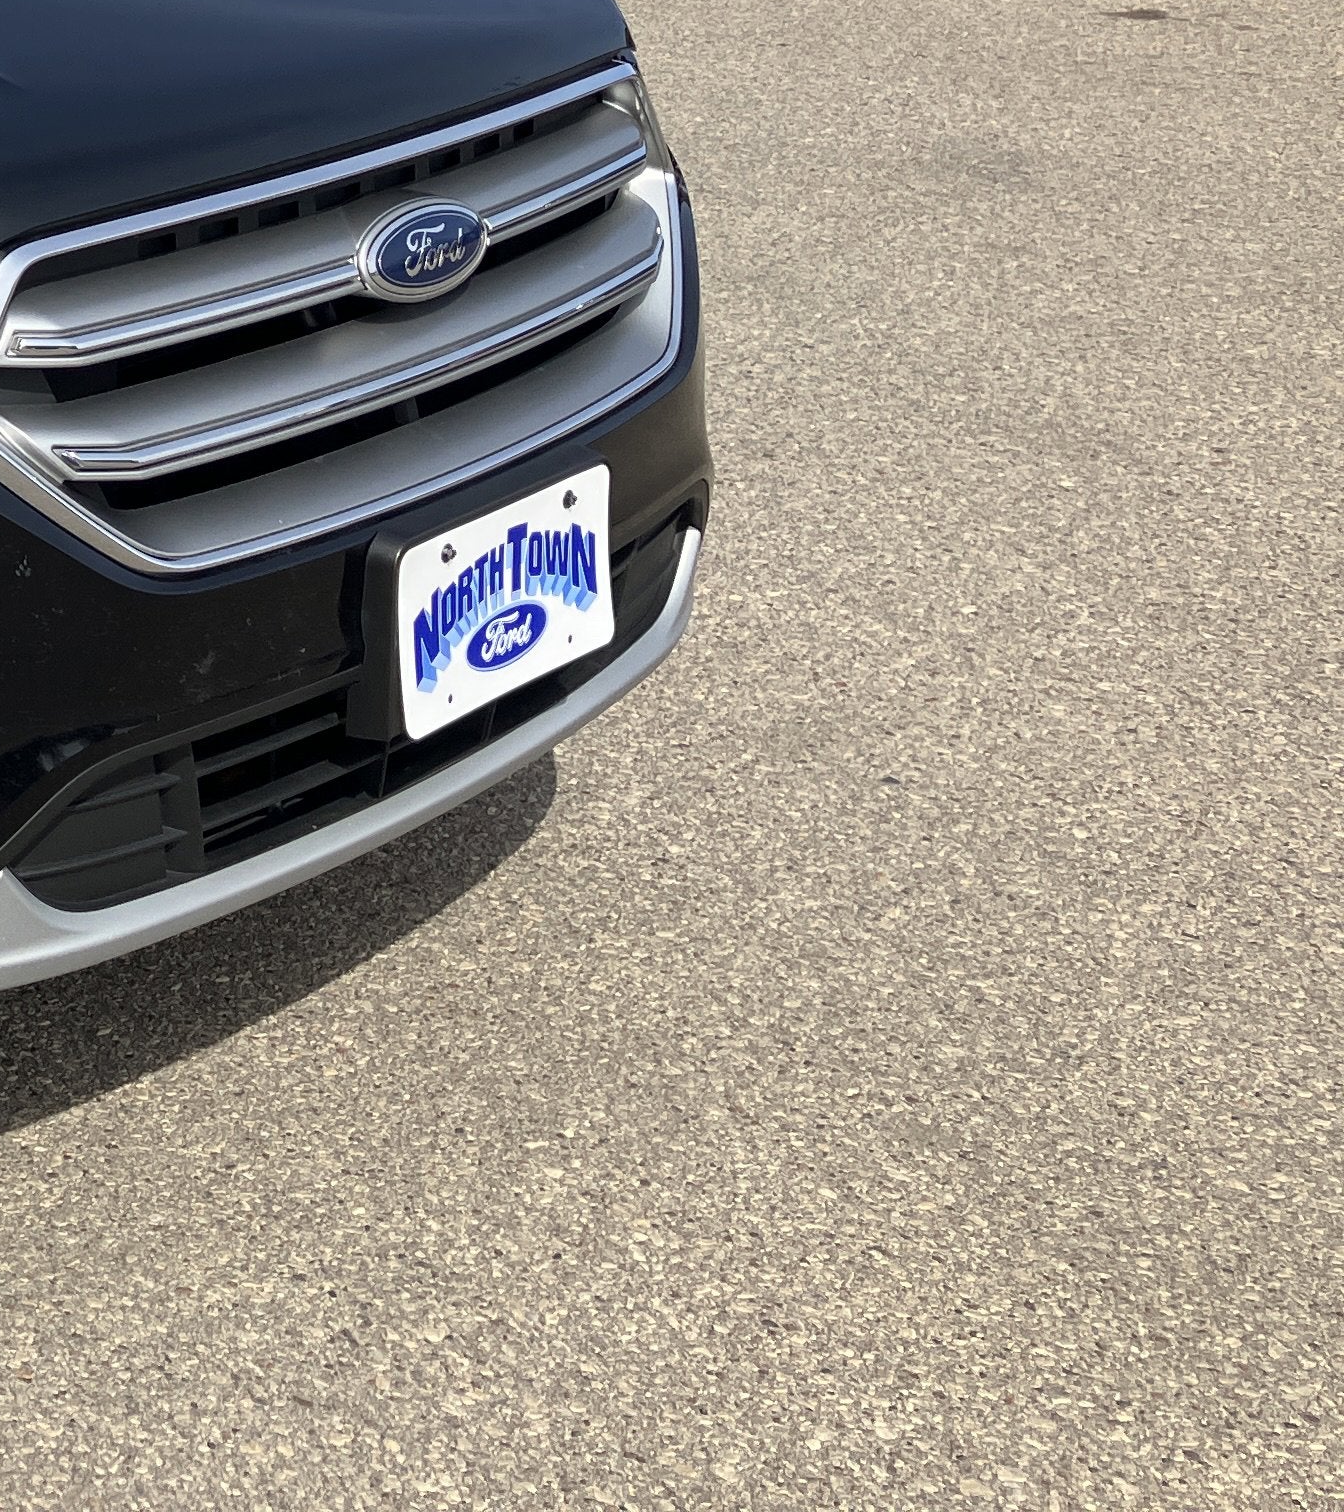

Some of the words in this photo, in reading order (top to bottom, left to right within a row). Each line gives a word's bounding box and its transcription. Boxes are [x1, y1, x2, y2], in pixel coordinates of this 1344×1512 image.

[404, 222, 466, 277] Ford
[414, 543, 505, 691] NORTH
[507, 521, 598, 610] TOWN
[480, 610, 532, 663] Ford
